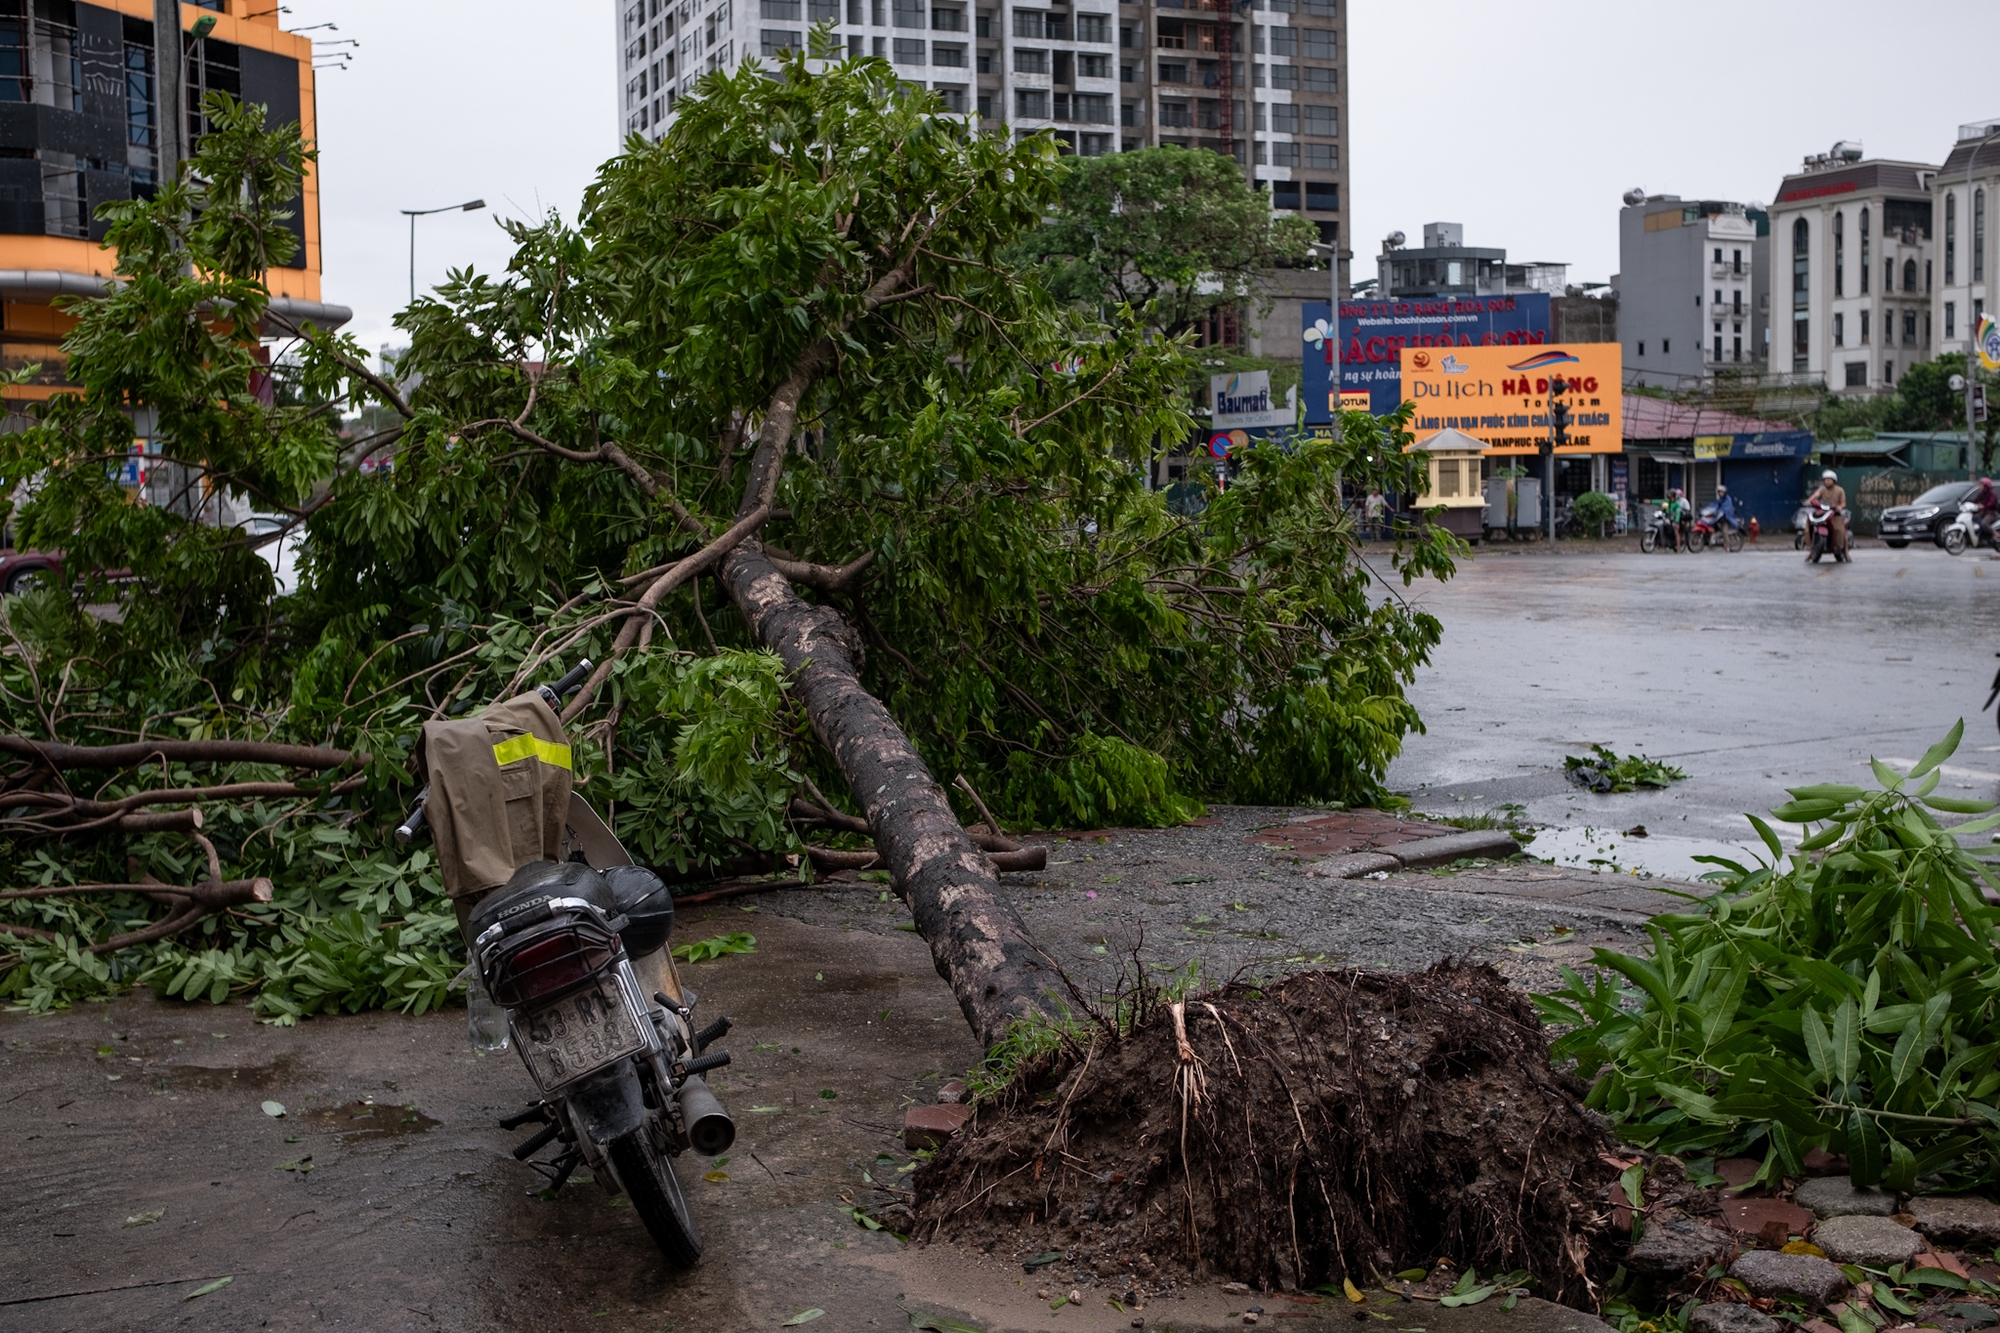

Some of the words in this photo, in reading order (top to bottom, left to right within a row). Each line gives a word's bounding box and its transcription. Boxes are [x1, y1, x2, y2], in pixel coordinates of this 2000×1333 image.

[1338, 302, 1367, 318] ÔNG
[1371, 304, 1389, 317] TY
[1392, 303, 1410, 316] CP
[1413, 298, 1450, 316] BÁCH
[1454, 297, 1484, 314] HÓA
[1357, 317, 1393, 327] Website:
[1328, 369, 1359, 384] ng
[1413, 381, 1440, 398] Du
[1447, 379, 1494, 400] lịch
[1501, 373, 1532, 396] HÀ
[1217, 389, 1268, 415] Baumati
[1415, 414, 1440, 430] LÀNG
[1480, 413, 1505, 429] PHÚC
[1507, 412, 1529, 428] KÍNH
[1578, 411, 1610, 426] KHÁCH
[1491, 436, 1531, 448] VANPHUC
[497, 894, 555, 920] HONDA
[546, 1021, 623, 1077] 8533
